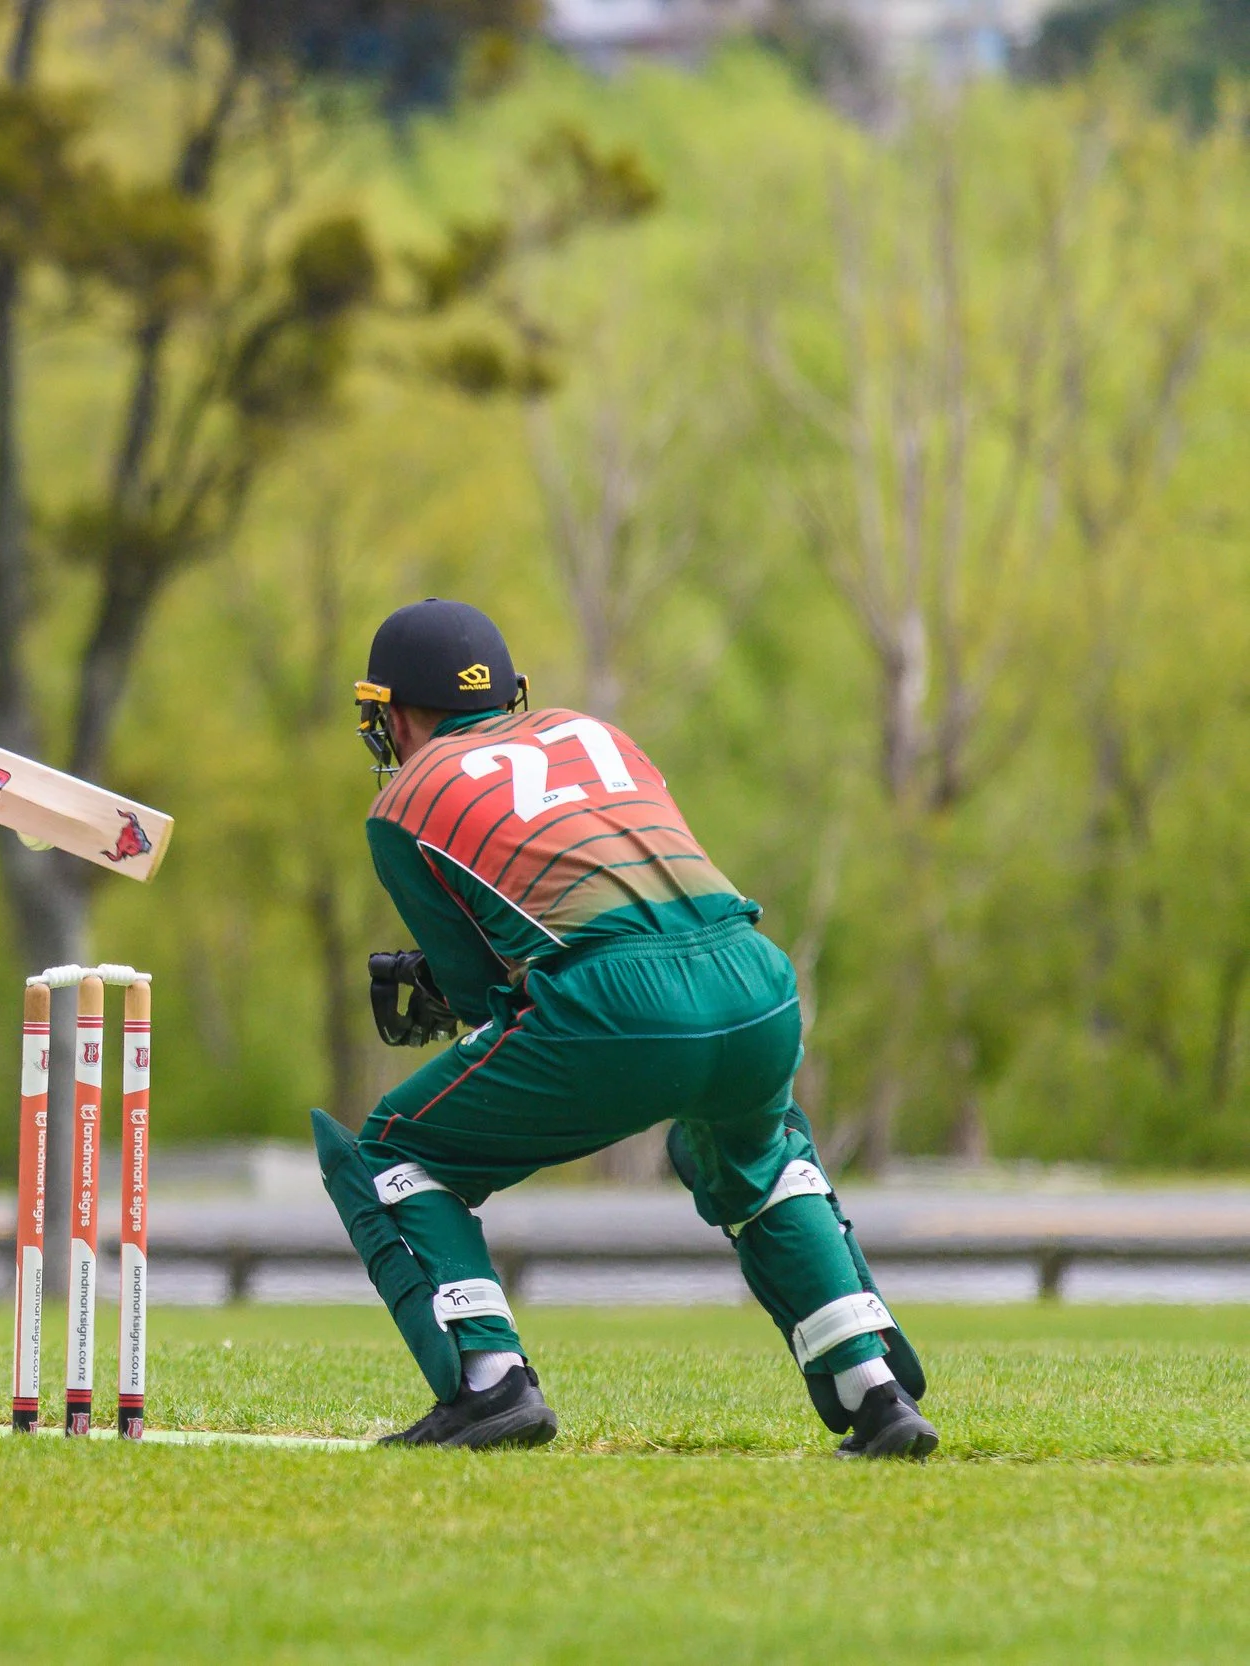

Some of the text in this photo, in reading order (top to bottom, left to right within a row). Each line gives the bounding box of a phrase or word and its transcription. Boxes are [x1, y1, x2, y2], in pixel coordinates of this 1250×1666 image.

[461, 718, 638, 823] 27
[33, 1130, 47, 1234] landmark signs
[78, 1122, 95, 1227] landmark signs
[129, 1127, 145, 1232] landmark signs
[31, 1268, 42, 1390] landmarksigns.co.nz
[77, 1261, 90, 1381] landmarksigns.co.nz
[129, 1265, 143, 1386] landmarksigns.co.nz
